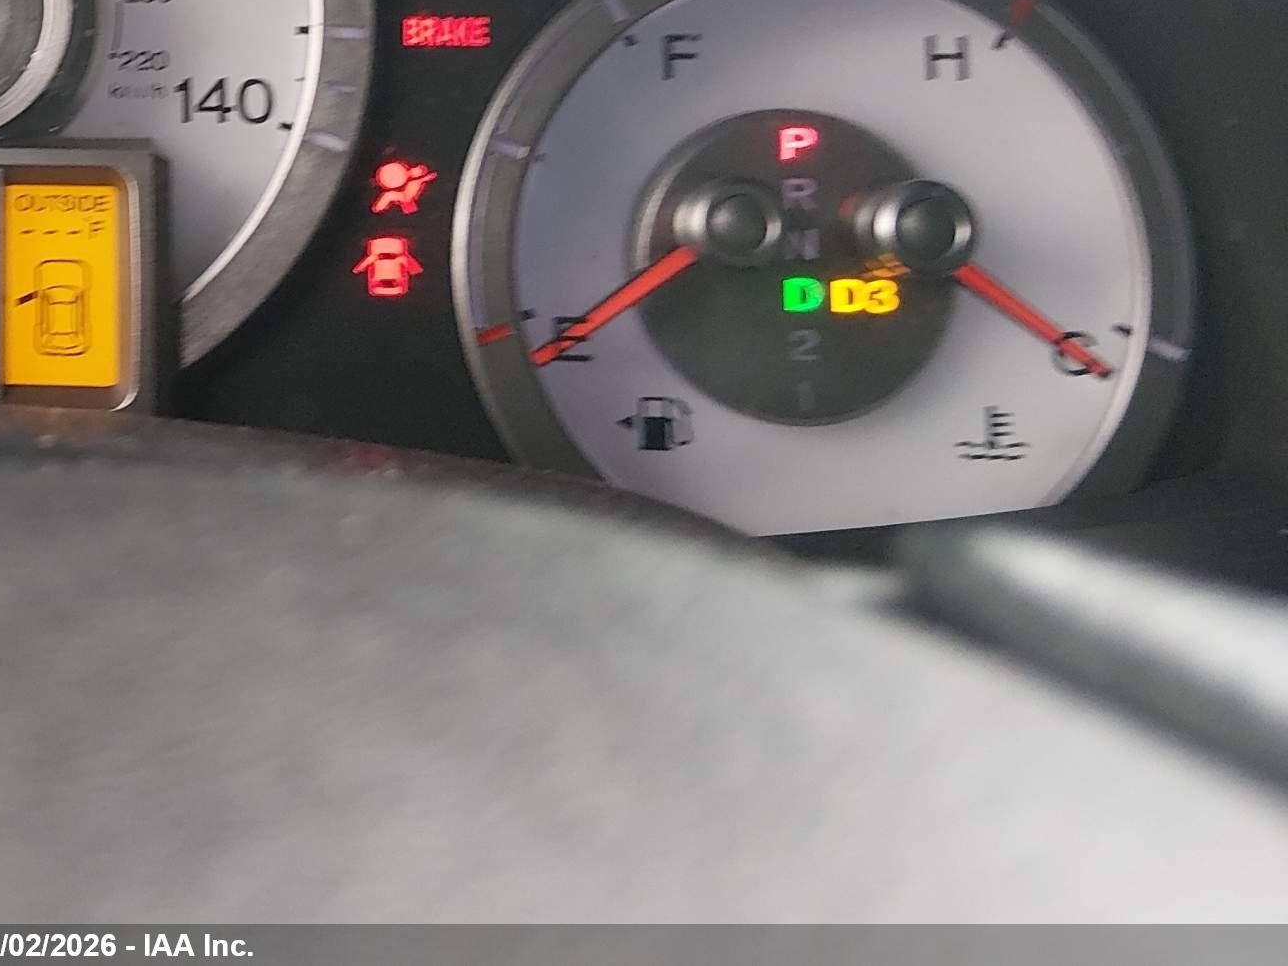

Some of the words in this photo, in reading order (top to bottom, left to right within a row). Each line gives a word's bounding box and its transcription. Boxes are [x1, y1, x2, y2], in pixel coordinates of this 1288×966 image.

[402, 15, 491, 48] BRAKE
[117, 50, 170, 71] 220
[663, 34, 702, 81] F
[924, 35, 969, 81] H
[173, 77, 274, 124] 140
[778, 127, 819, 161] P
[15, 194, 111, 212] OUTSIDE
[782, 277, 824, 312] D
[829, 278, 900, 314] D3
[789, 330, 822, 361] 2
